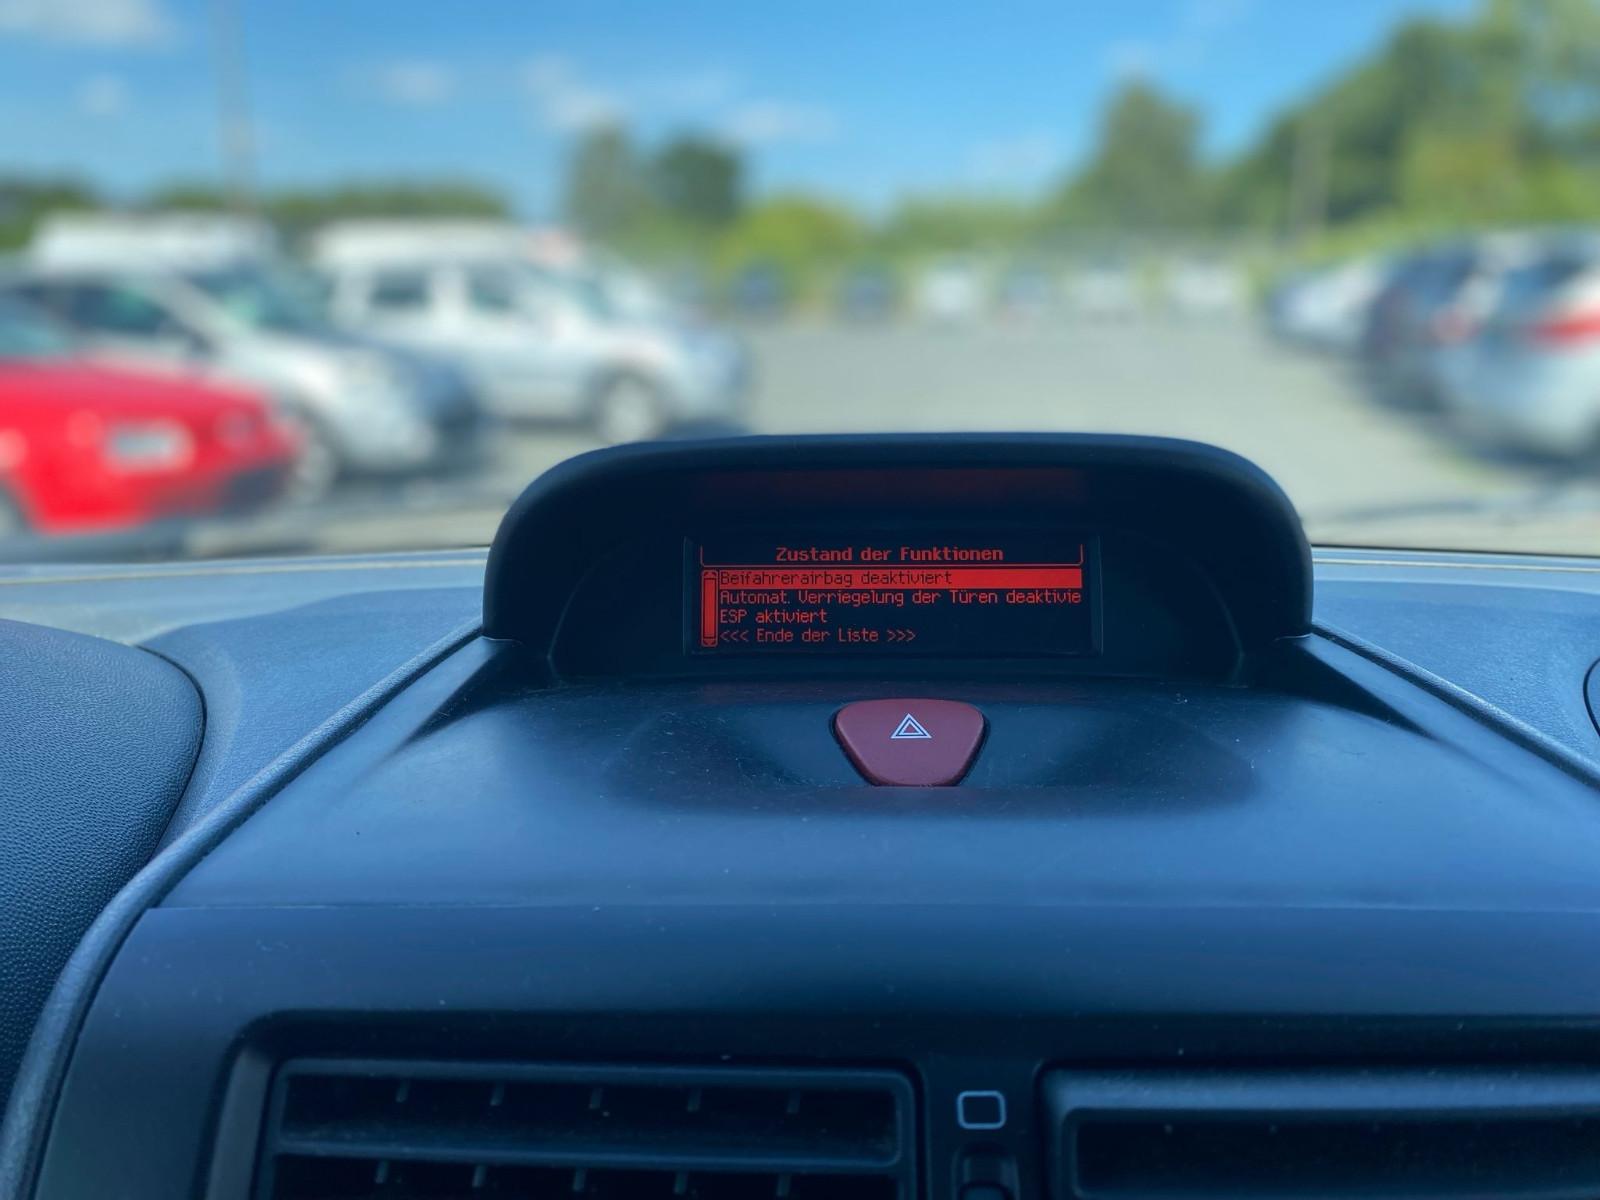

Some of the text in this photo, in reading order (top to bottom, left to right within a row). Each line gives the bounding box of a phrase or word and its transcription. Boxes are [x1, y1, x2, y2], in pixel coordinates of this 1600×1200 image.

[776, 546, 1004, 561] Zustand der Funktionen
[720, 570, 952, 588] Beifahrerairbag deaktiviert
[720, 589, 1081, 607] Automat. Verriegelung der Türen deaktivie
[720, 608, 828, 624] ESP aktiviert
[757, 628, 794, 642] Ende
[801, 628, 831, 642] der
[837, 628, 879, 642] Liste
